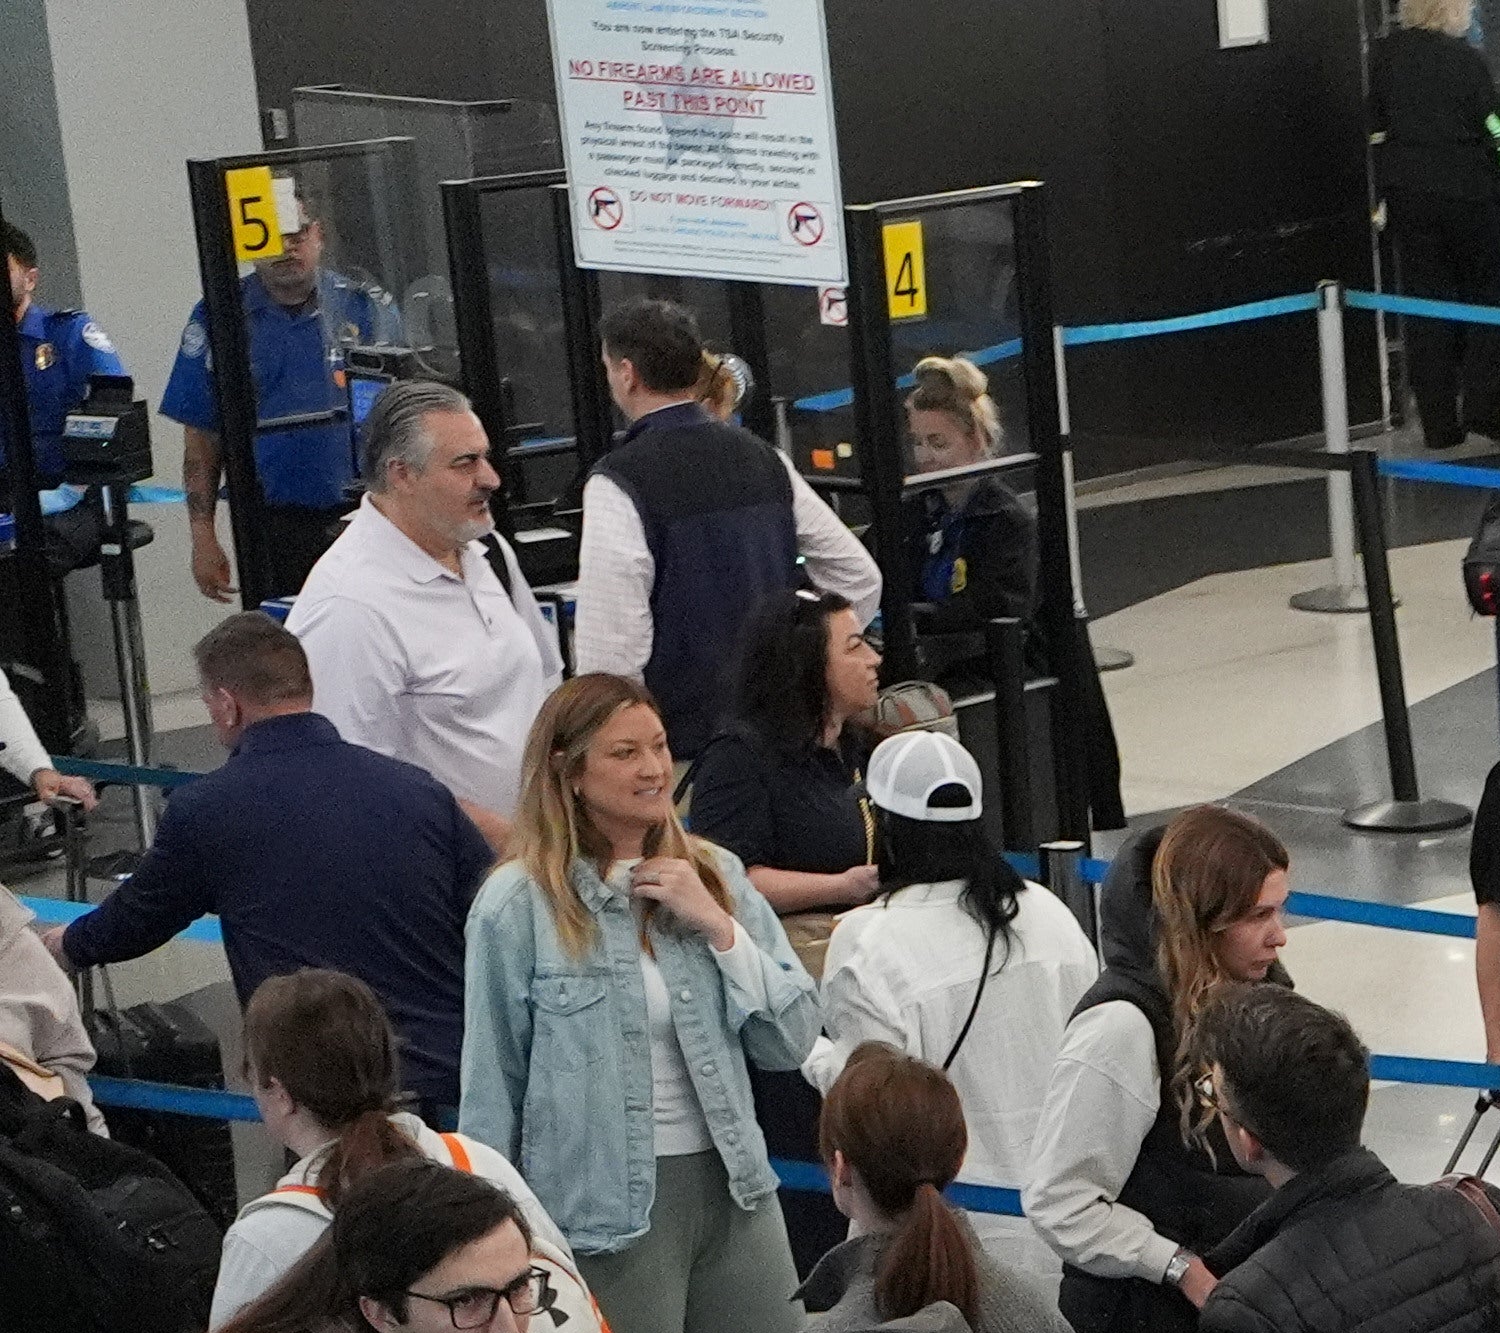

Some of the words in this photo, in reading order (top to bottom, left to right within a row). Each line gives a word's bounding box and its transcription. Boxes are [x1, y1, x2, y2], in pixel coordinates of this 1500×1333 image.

[569, 59, 593, 76] NO
[599, 61, 685, 82] FIREARMS
[692, 67, 725, 84] ARE
[732, 69, 815, 90] ALLOWED
[624, 90, 666, 108] PAST
[674, 93, 709, 111] THIS
[716, 96, 766, 114] POINT
[240, 197, 268, 251] 5
[894, 252, 918, 307] 4
